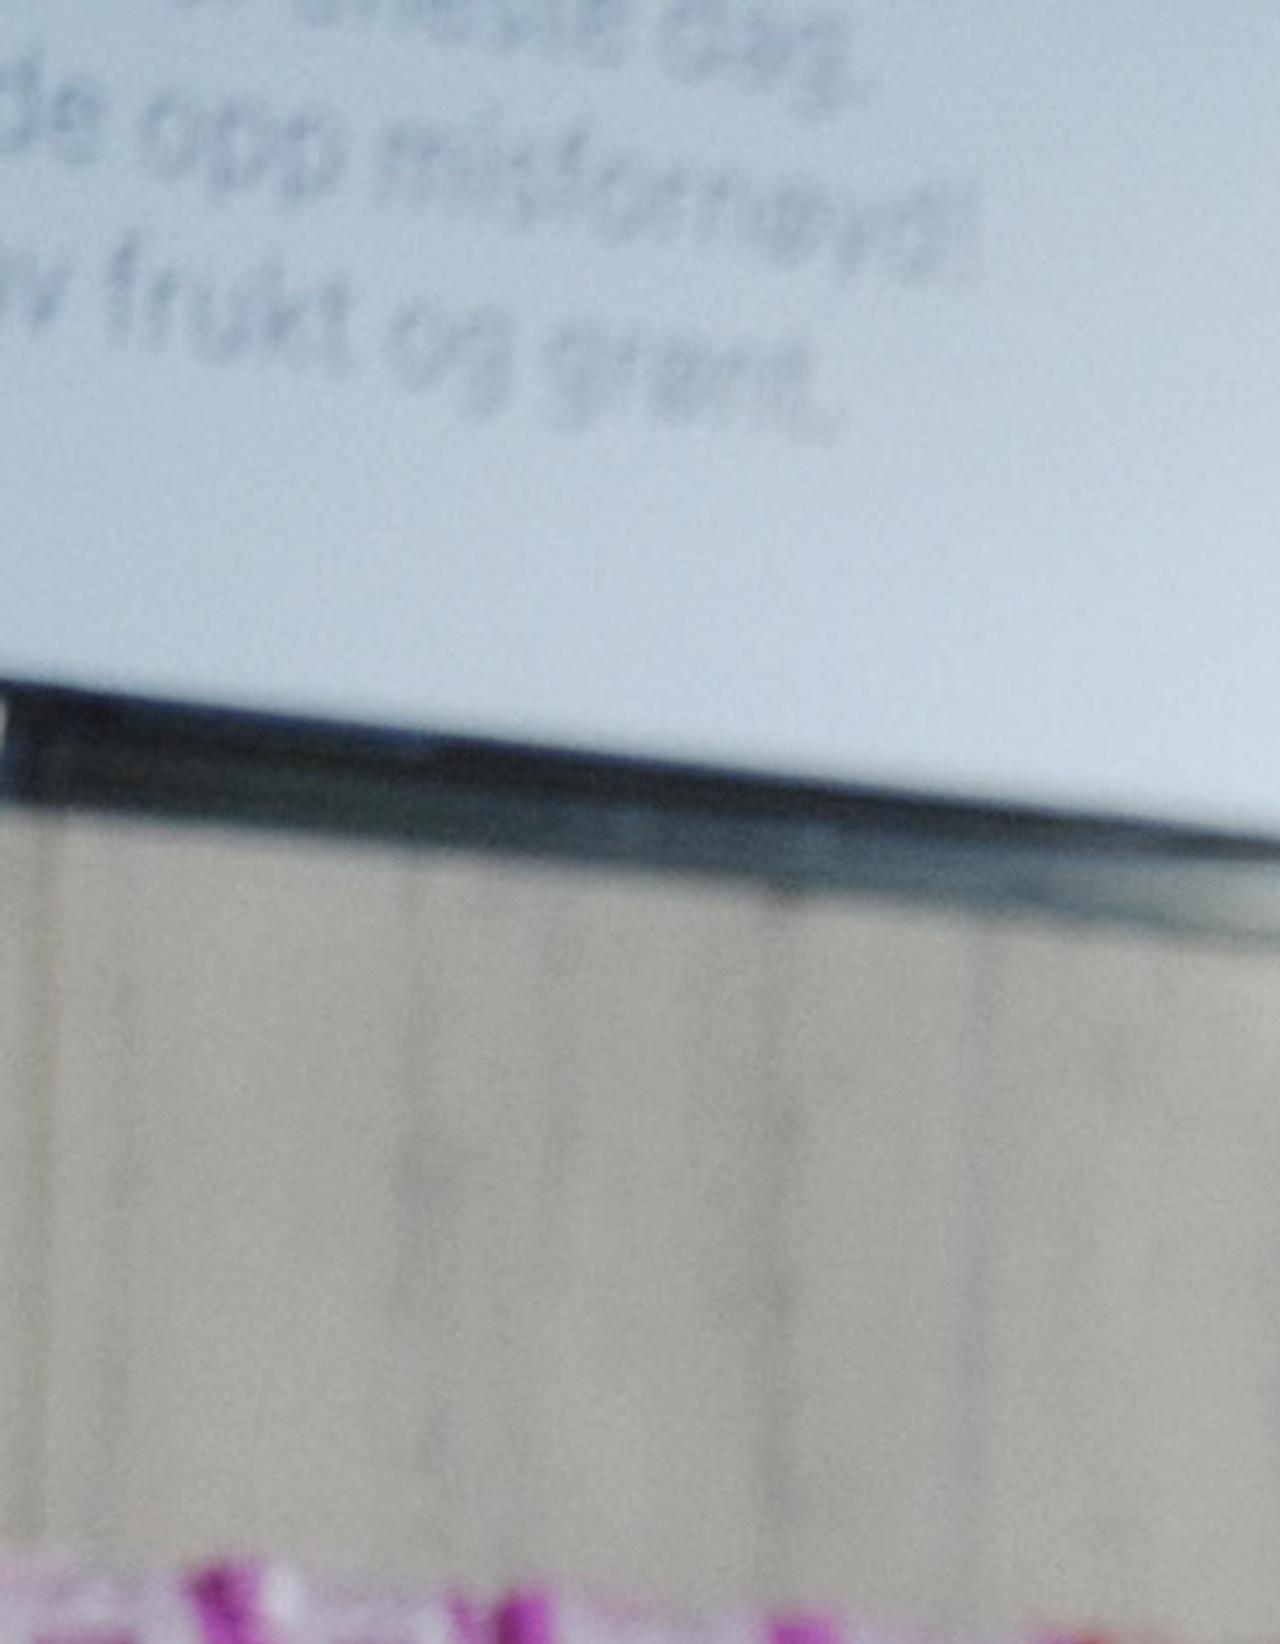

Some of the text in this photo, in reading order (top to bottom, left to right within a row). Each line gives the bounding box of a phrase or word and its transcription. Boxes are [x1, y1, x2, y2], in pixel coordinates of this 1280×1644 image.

[137, 85, 350, 212] opp
[103, 226, 355, 380] frukt
[386, 295, 516, 426] og
